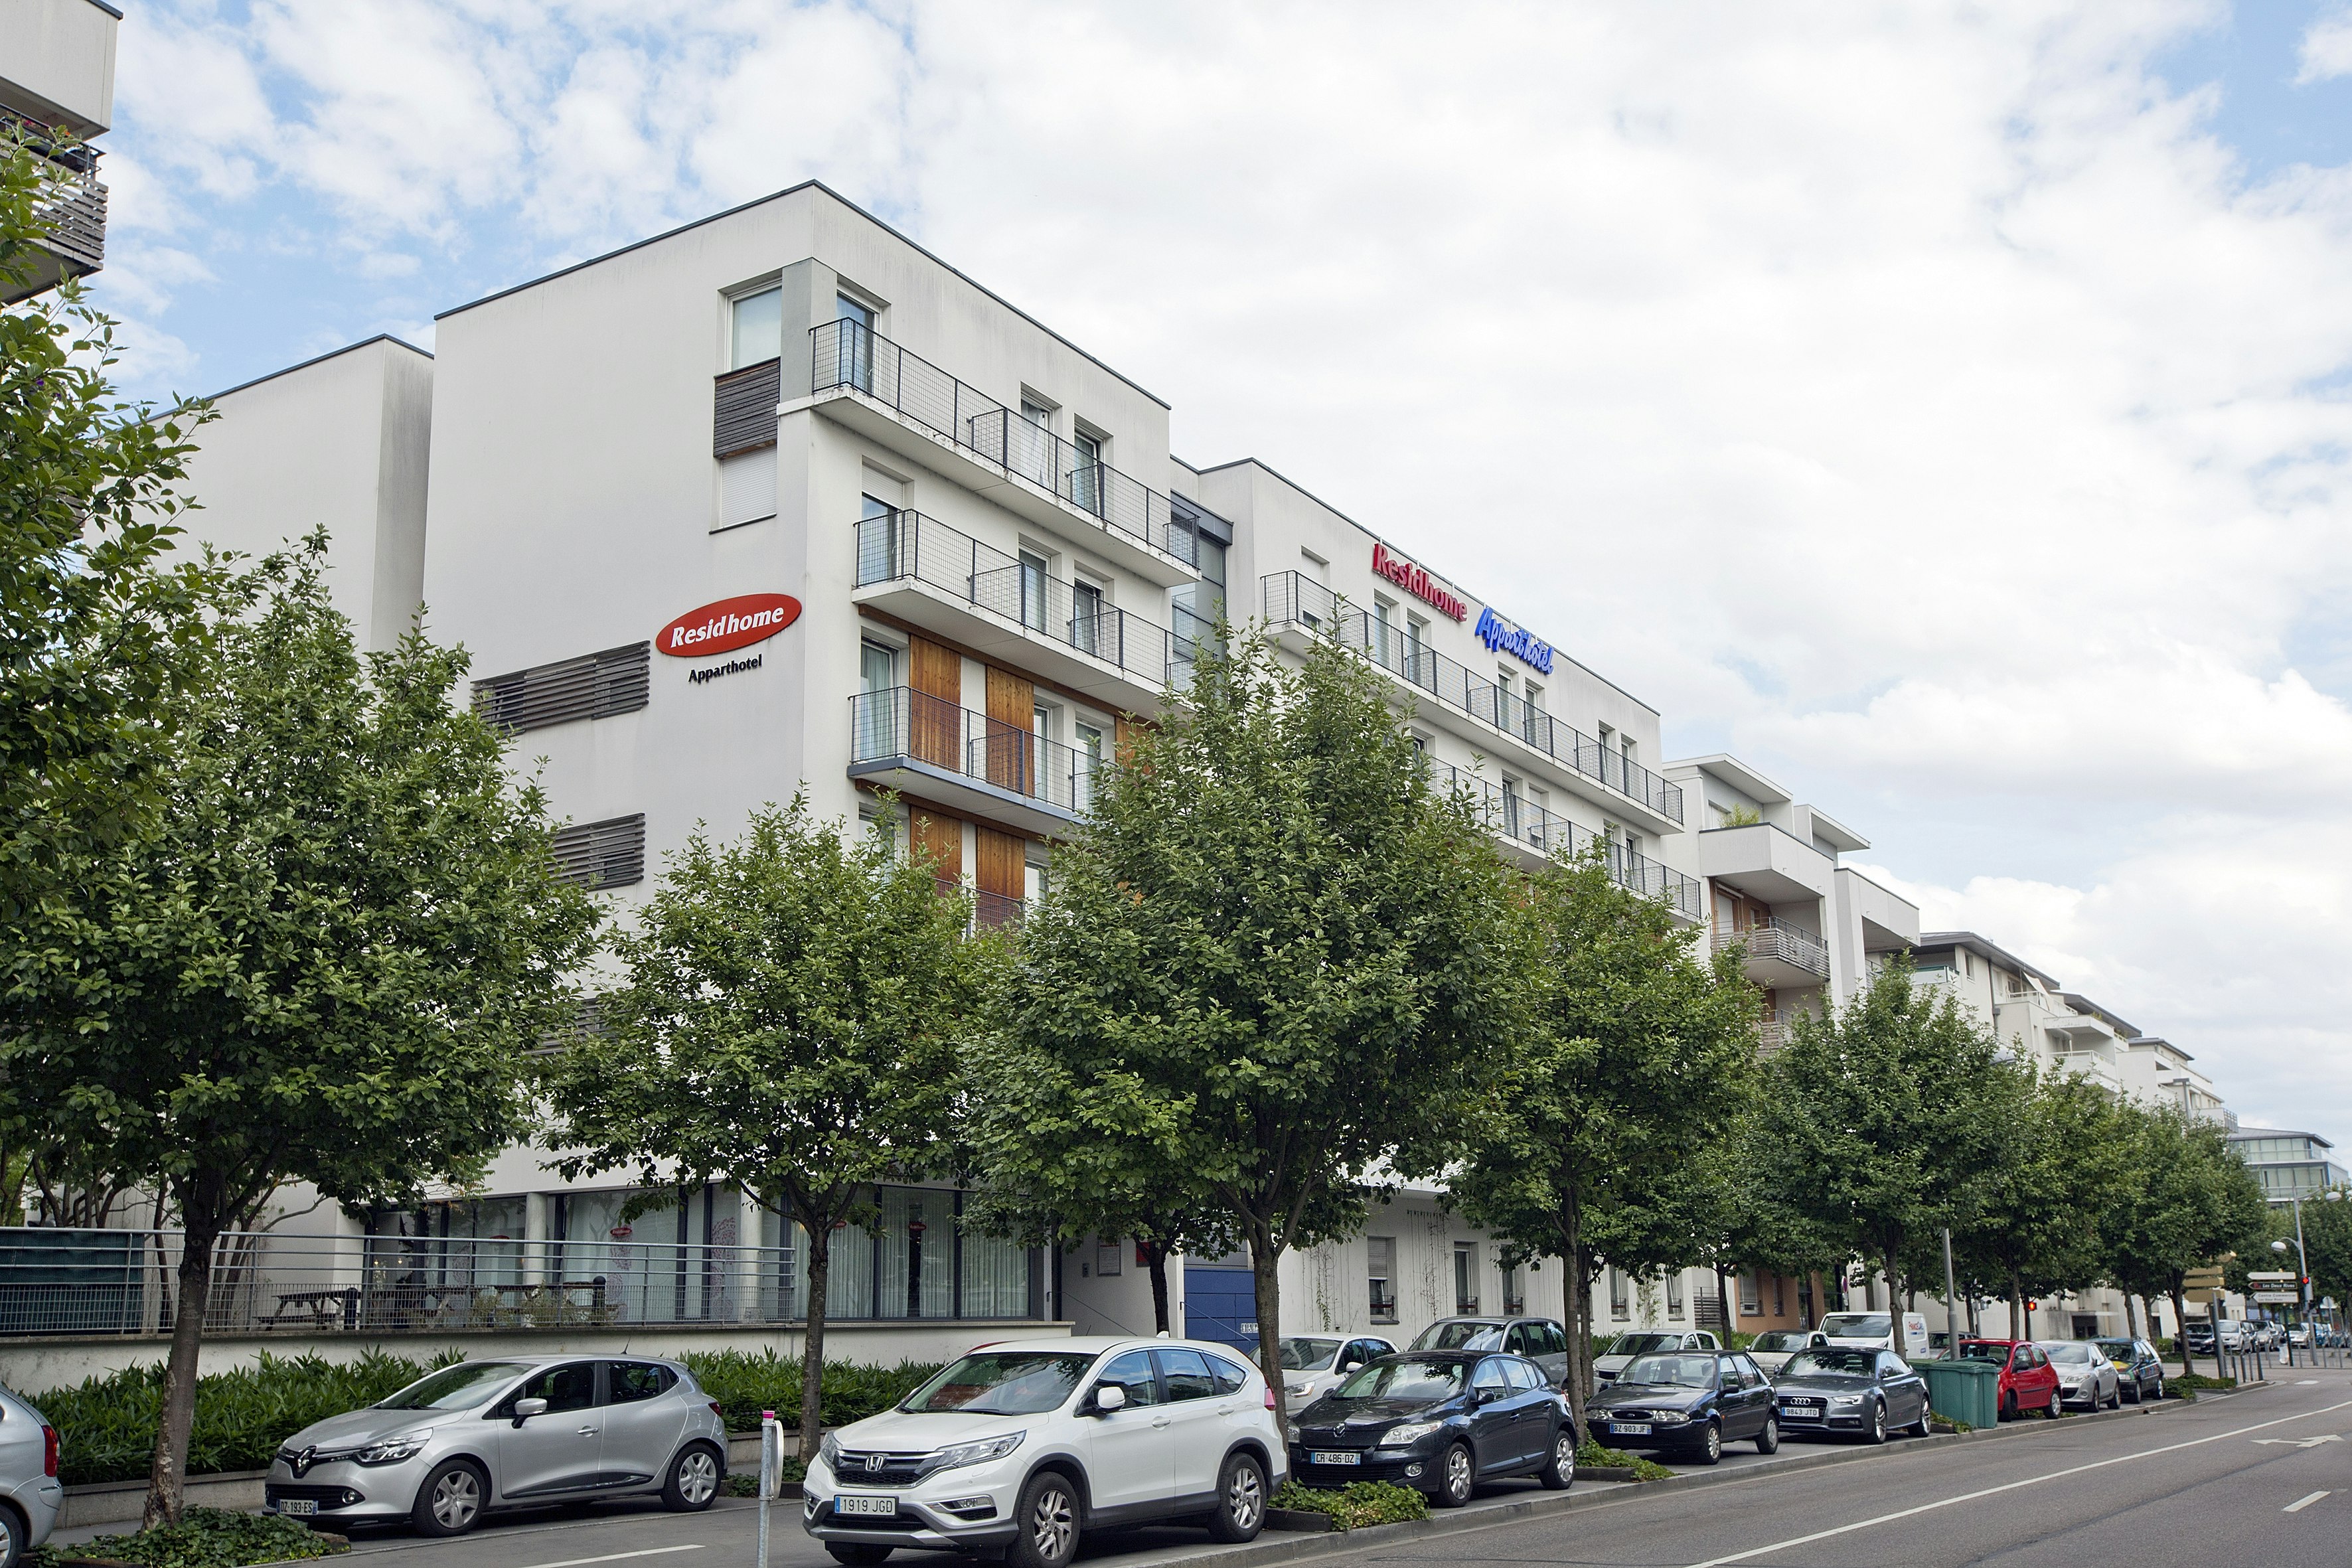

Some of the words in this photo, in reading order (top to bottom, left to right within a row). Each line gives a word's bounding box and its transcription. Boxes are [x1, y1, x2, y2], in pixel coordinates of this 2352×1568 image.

[1372, 542, 1468, 622] Residhome
[670, 607, 784, 649] Residhome
[1475, 607, 1554, 675] Apparthotel
[688, 654, 762, 684] Apparthotel
[1316, 1453, 1354, 1463] CR-486-DZ
[281, 1501, 313, 1513] DZ-193-ES
[844, 1498, 868, 1512] 1919
[872, 1500, 893, 1512] JGD
